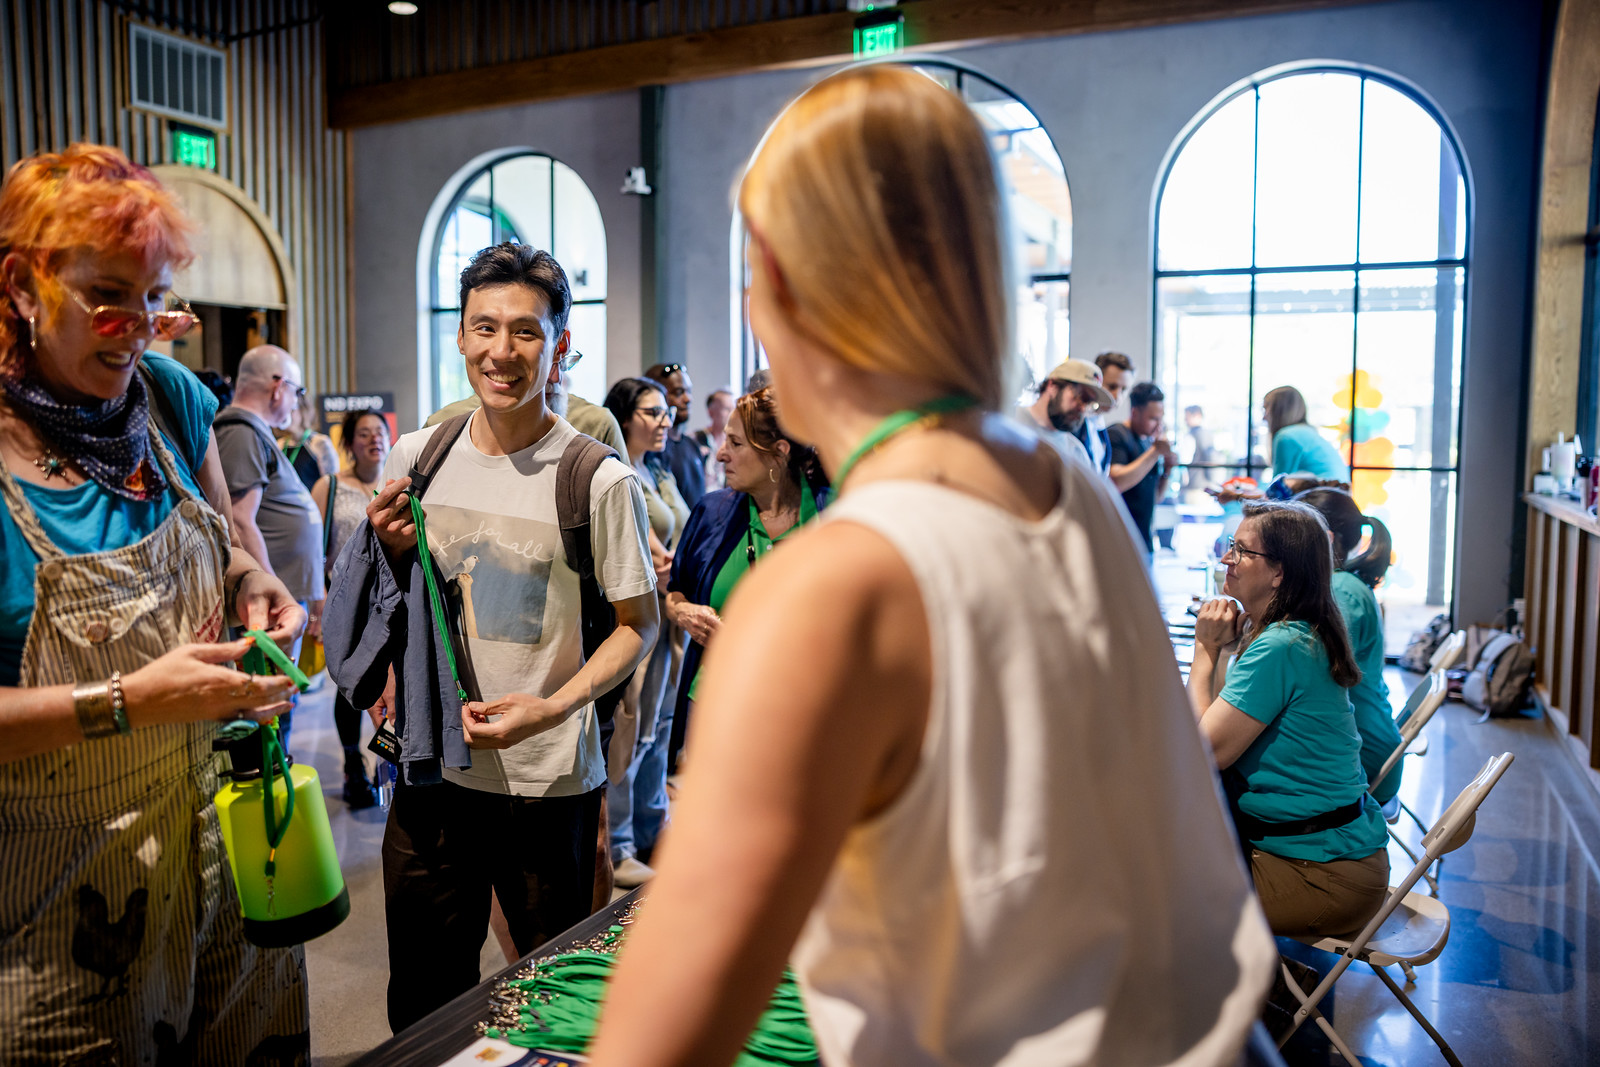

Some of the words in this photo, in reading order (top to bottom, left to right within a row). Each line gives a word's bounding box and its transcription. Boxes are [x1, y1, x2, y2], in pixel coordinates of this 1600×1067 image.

[864, 27, 897, 57] EXIT
[181, 136, 208, 164] EXIT
[347, 396, 383, 411] EXPO
[471, 519, 503, 545] for
[507, 540, 553, 562] all
